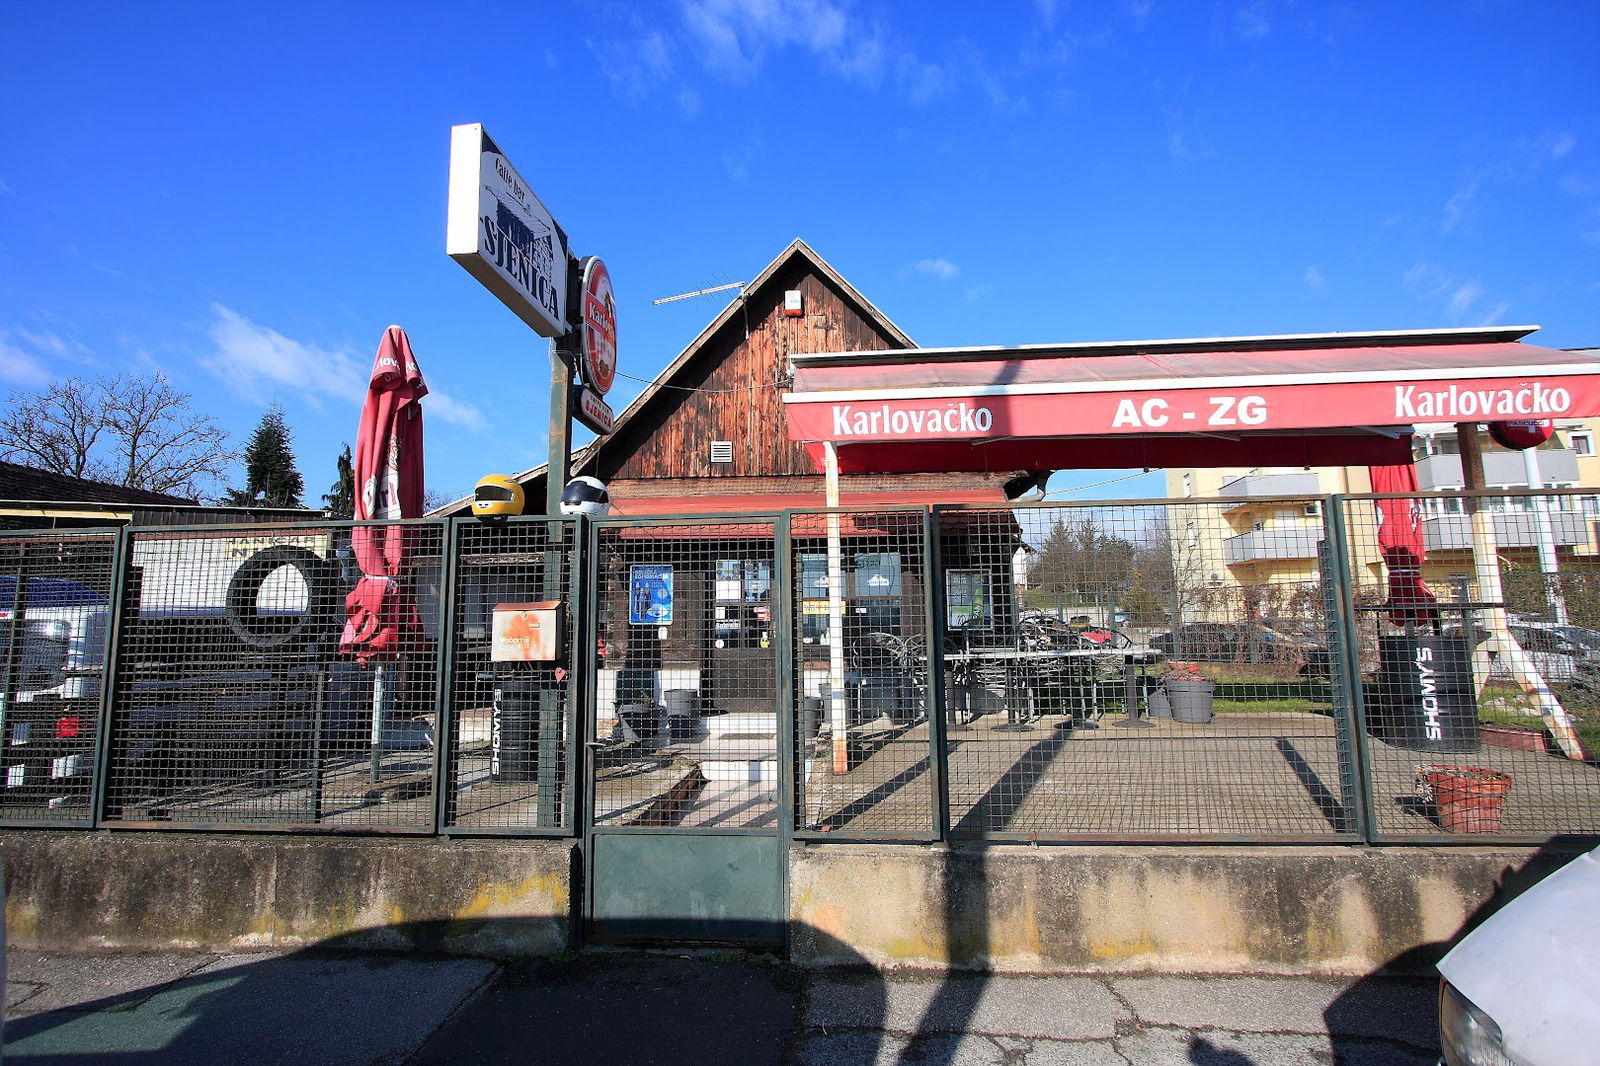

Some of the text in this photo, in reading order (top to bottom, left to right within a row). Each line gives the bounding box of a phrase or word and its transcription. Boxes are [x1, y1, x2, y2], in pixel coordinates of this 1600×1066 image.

[1112, 398, 1169, 427] AC
[1208, 395, 1267, 426] ZG
[1394, 382, 1571, 418] Karlovačko
[832, 402, 993, 437] Karlovačko
